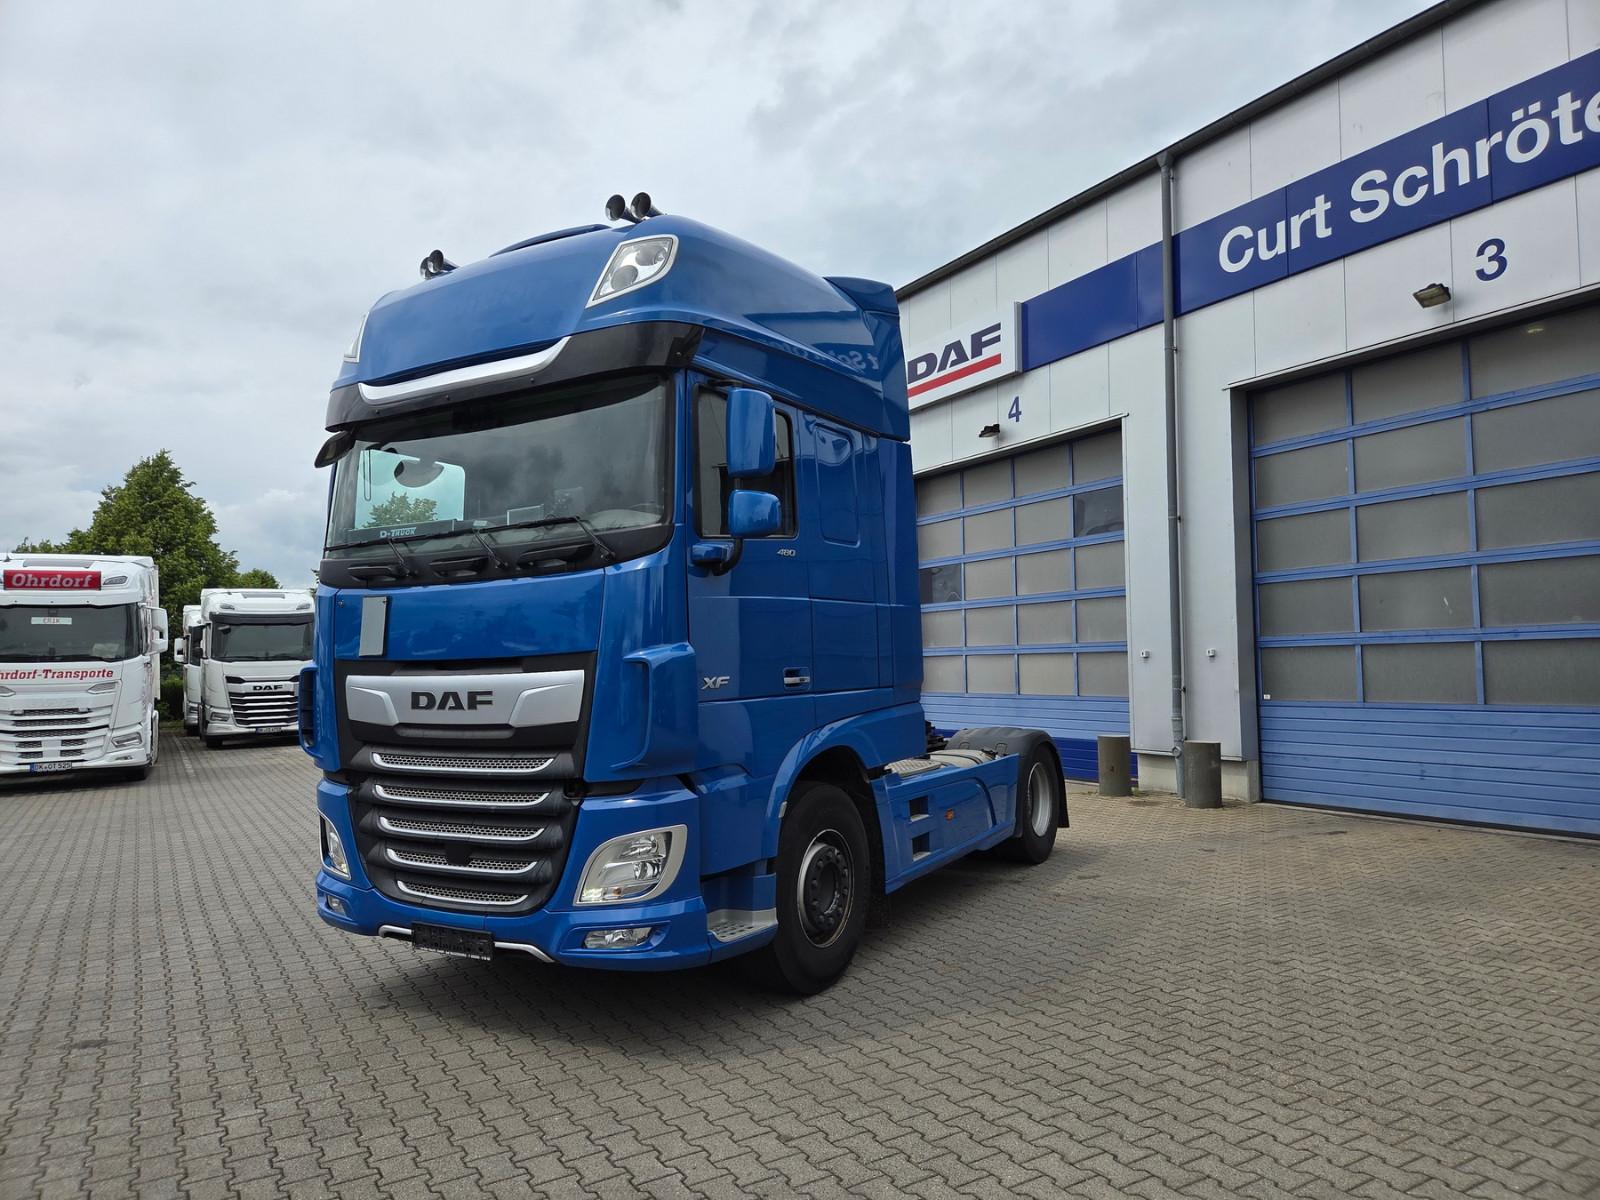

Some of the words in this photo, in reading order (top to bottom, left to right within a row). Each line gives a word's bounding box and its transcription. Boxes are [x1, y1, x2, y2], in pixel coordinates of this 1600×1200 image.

[1218, 194, 1332, 273] Curt
[1475, 238, 1508, 282] 3
[907, 321, 1001, 385] DAF
[1008, 396, 1022, 423] 4
[777, 548, 797, 557] 480
[11, 573, 92, 588] Ohrdorf
[701, 676, 730, 690] XF
[411, 690, 493, 711] DAF
